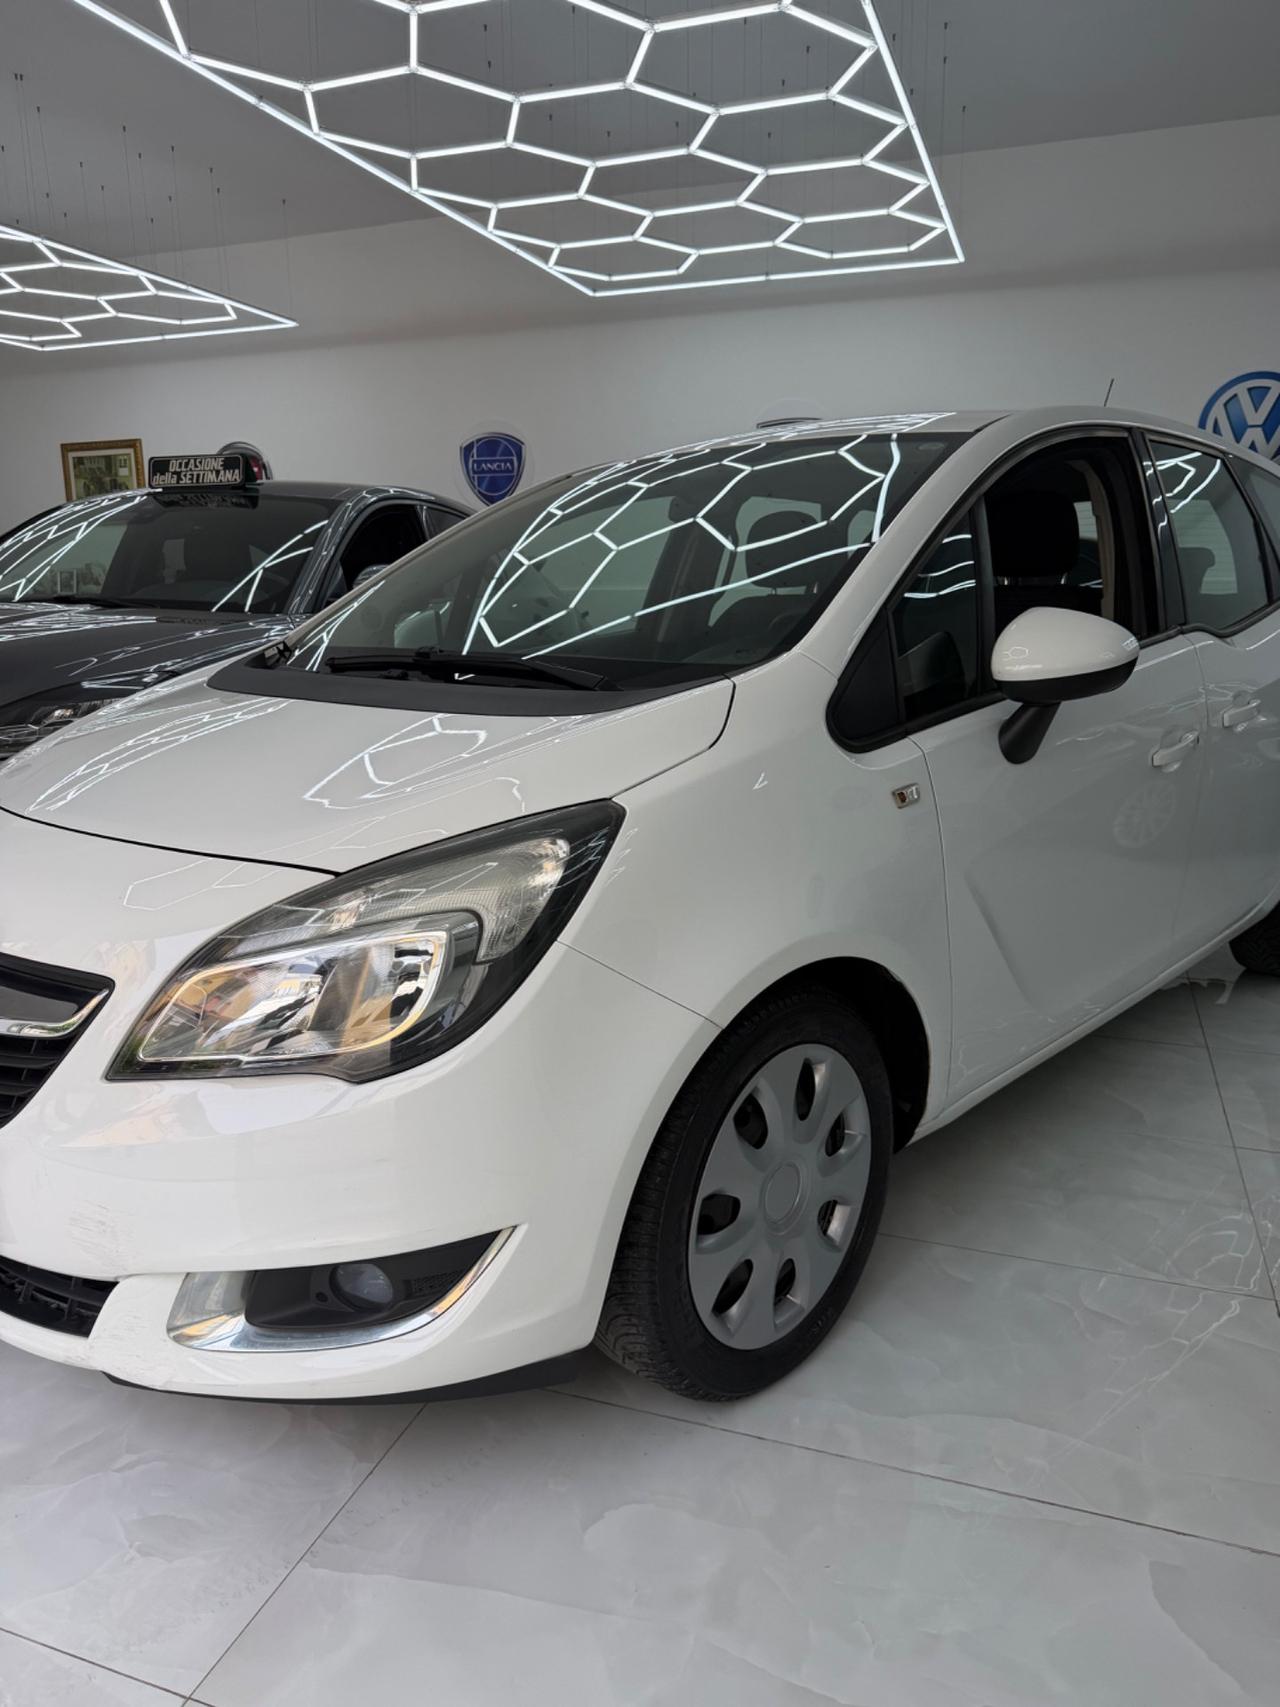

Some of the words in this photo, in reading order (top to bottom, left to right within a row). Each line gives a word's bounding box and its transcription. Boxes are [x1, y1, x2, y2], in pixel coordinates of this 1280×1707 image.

[169, 457, 224, 472] OCCASIONE
[474, 462, 512, 471] LANCIA
[152, 472, 178, 485] della
[179, 469, 240, 484] SETTIMANA
